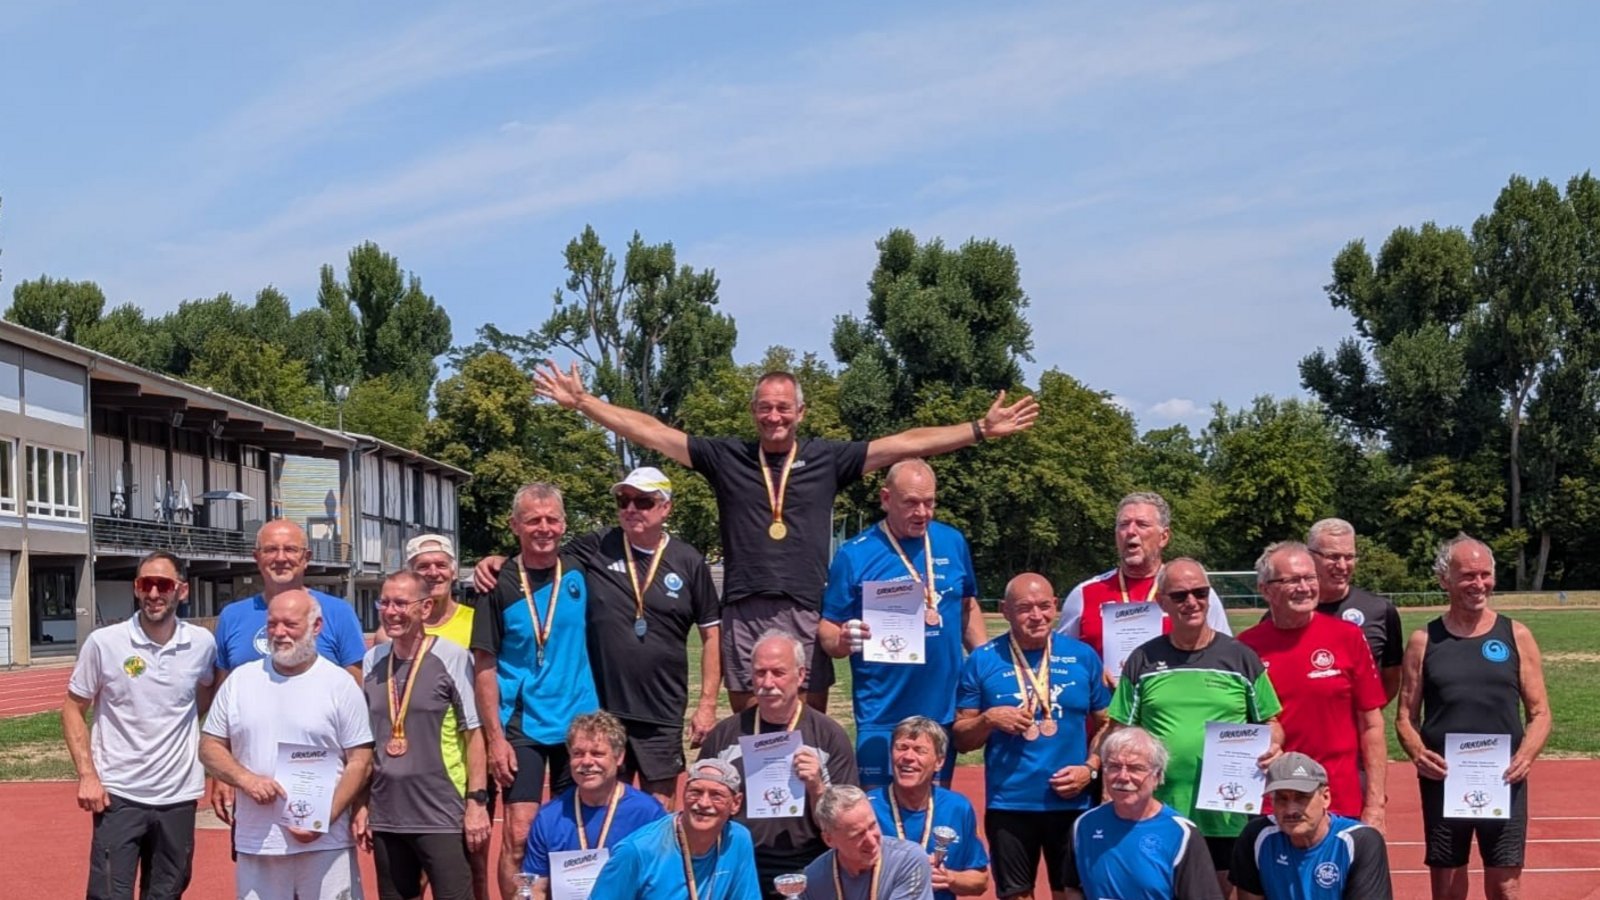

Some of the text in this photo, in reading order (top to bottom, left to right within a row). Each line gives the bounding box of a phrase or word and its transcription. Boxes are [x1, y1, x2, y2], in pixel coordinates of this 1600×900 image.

[1115, 605, 1150, 618] URKUNDE
[1219, 728, 1259, 739] URKUNDE
[1460, 738, 1499, 750] URKUNDE
